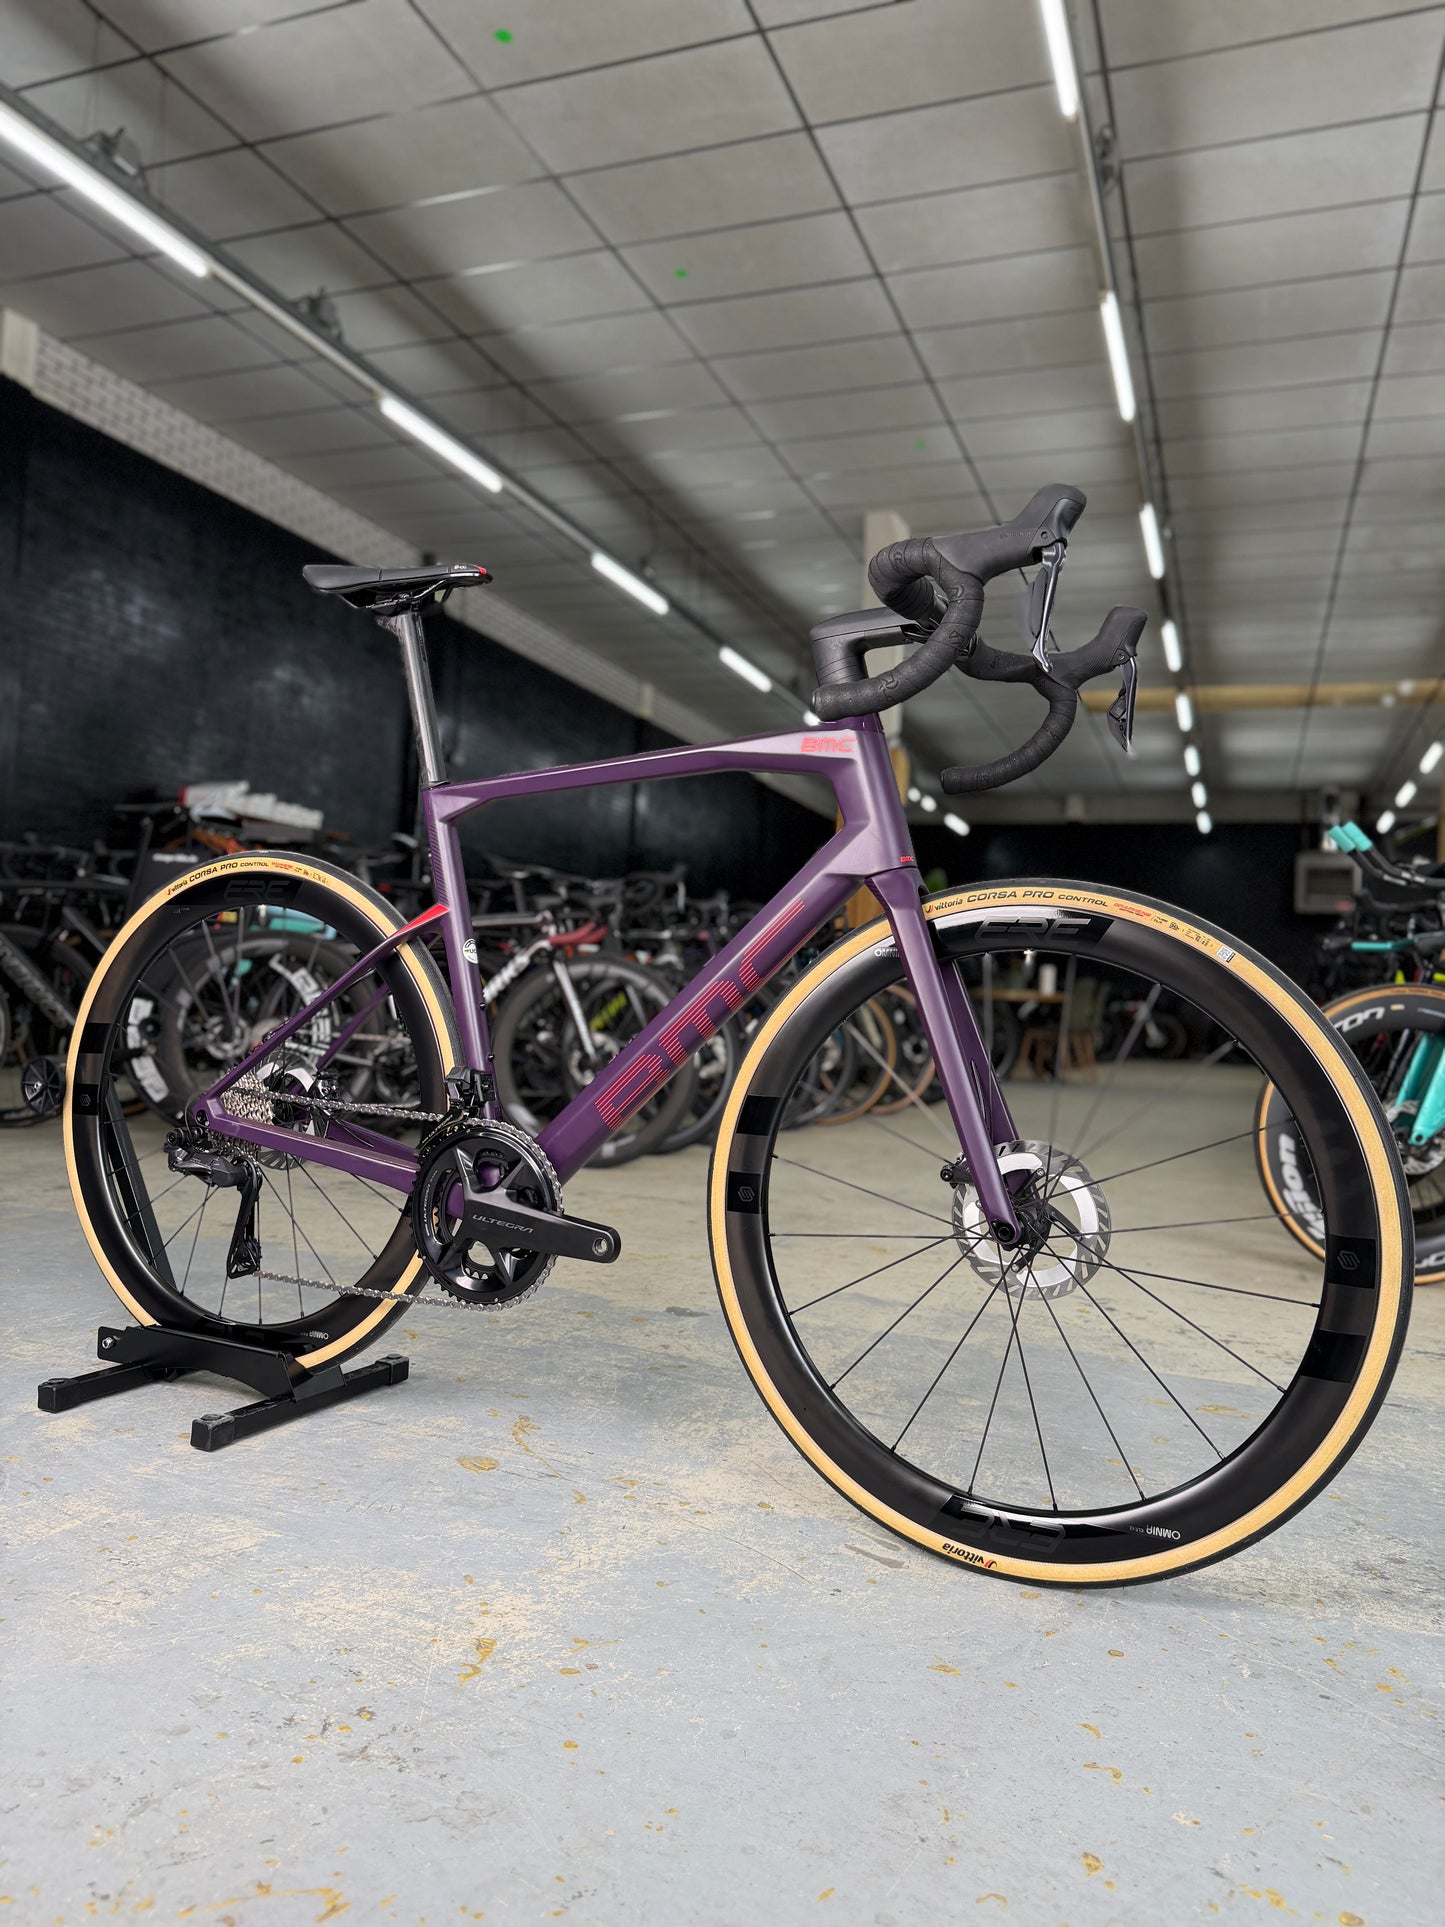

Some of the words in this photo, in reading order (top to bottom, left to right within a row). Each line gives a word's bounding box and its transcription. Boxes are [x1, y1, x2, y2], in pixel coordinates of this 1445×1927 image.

[800, 737, 857, 753] BMC
[171, 879, 188, 892] vittoria
[189, 868, 218, 883] CORSA
[220, 862, 238, 872] PRO
[935, 897, 964, 911] vittoria
[967, 890, 1017, 903] CORSA
[1022, 890, 1054, 899] PRO
[1058, 894, 1108, 908] CONTROL
[974, 915, 1092, 944] ERE
[472, 1213, 534, 1234] ULTEGRA
[942, 1542, 985, 1567] vittoria
